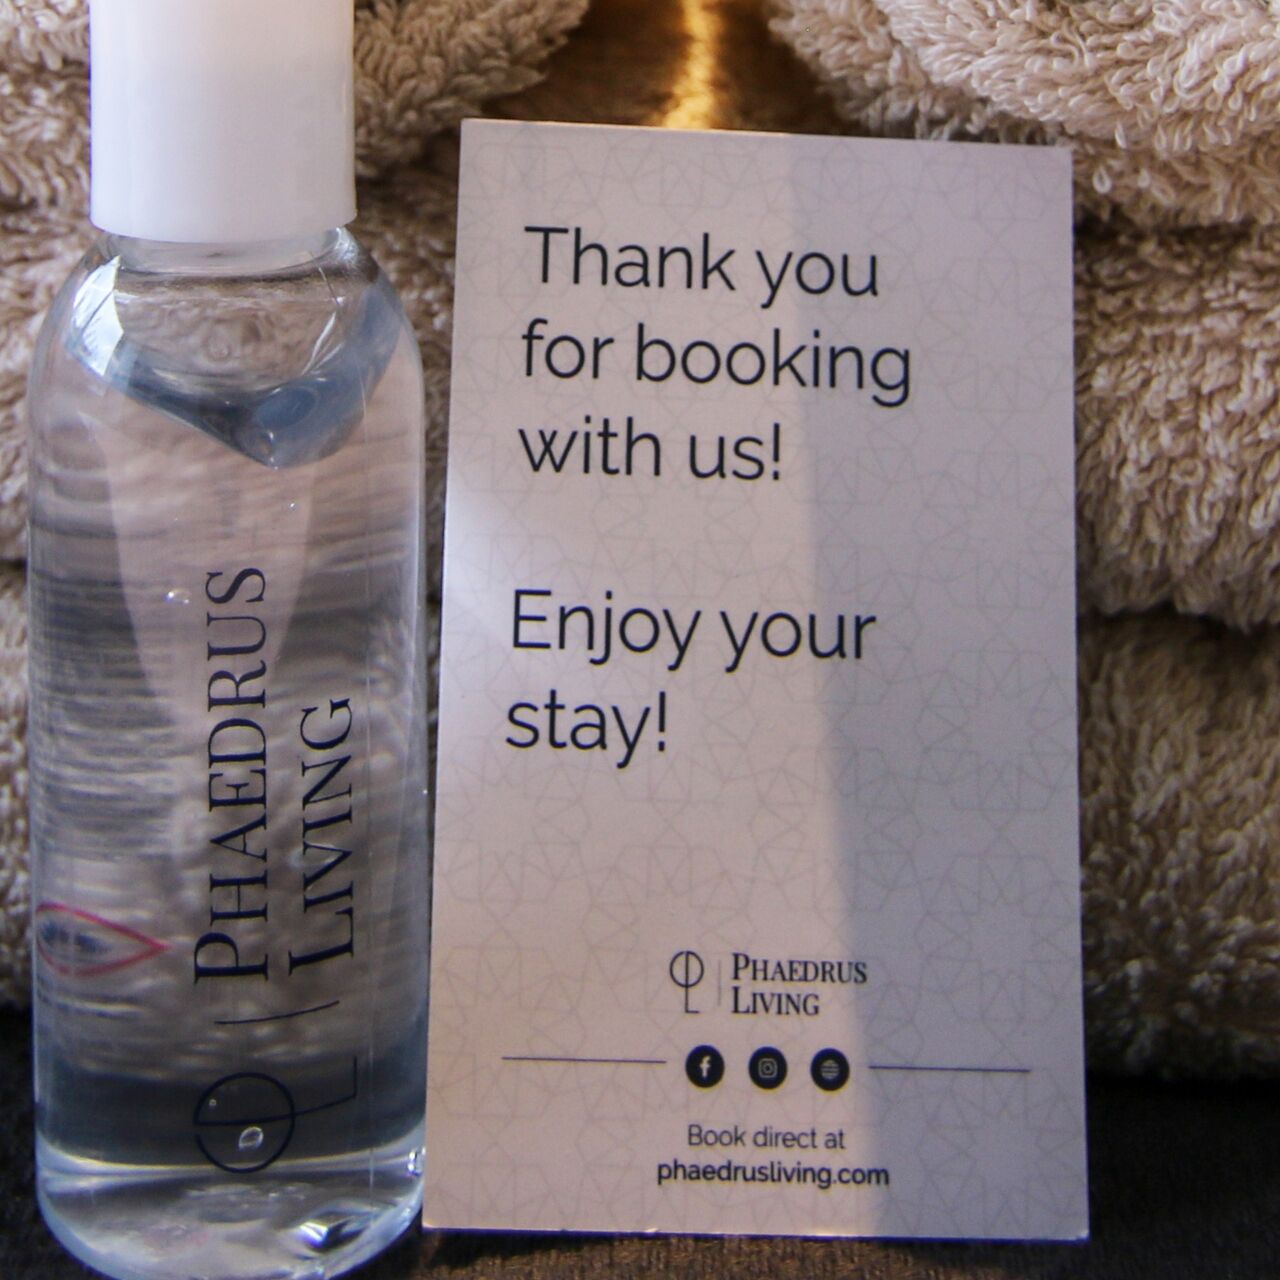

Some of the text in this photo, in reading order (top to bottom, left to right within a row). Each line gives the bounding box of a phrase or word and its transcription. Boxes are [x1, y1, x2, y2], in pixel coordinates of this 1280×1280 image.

[523, 226, 879, 309] Thank you
[521, 318, 912, 408] for booking
[518, 415, 782, 481] with us!
[511, 587, 877, 673] Enjoy your
[505, 689, 667, 769] stay!
[656, 1157, 890, 1189] phaedrusliving.com
[686, 1124, 846, 1151] Book direct at
